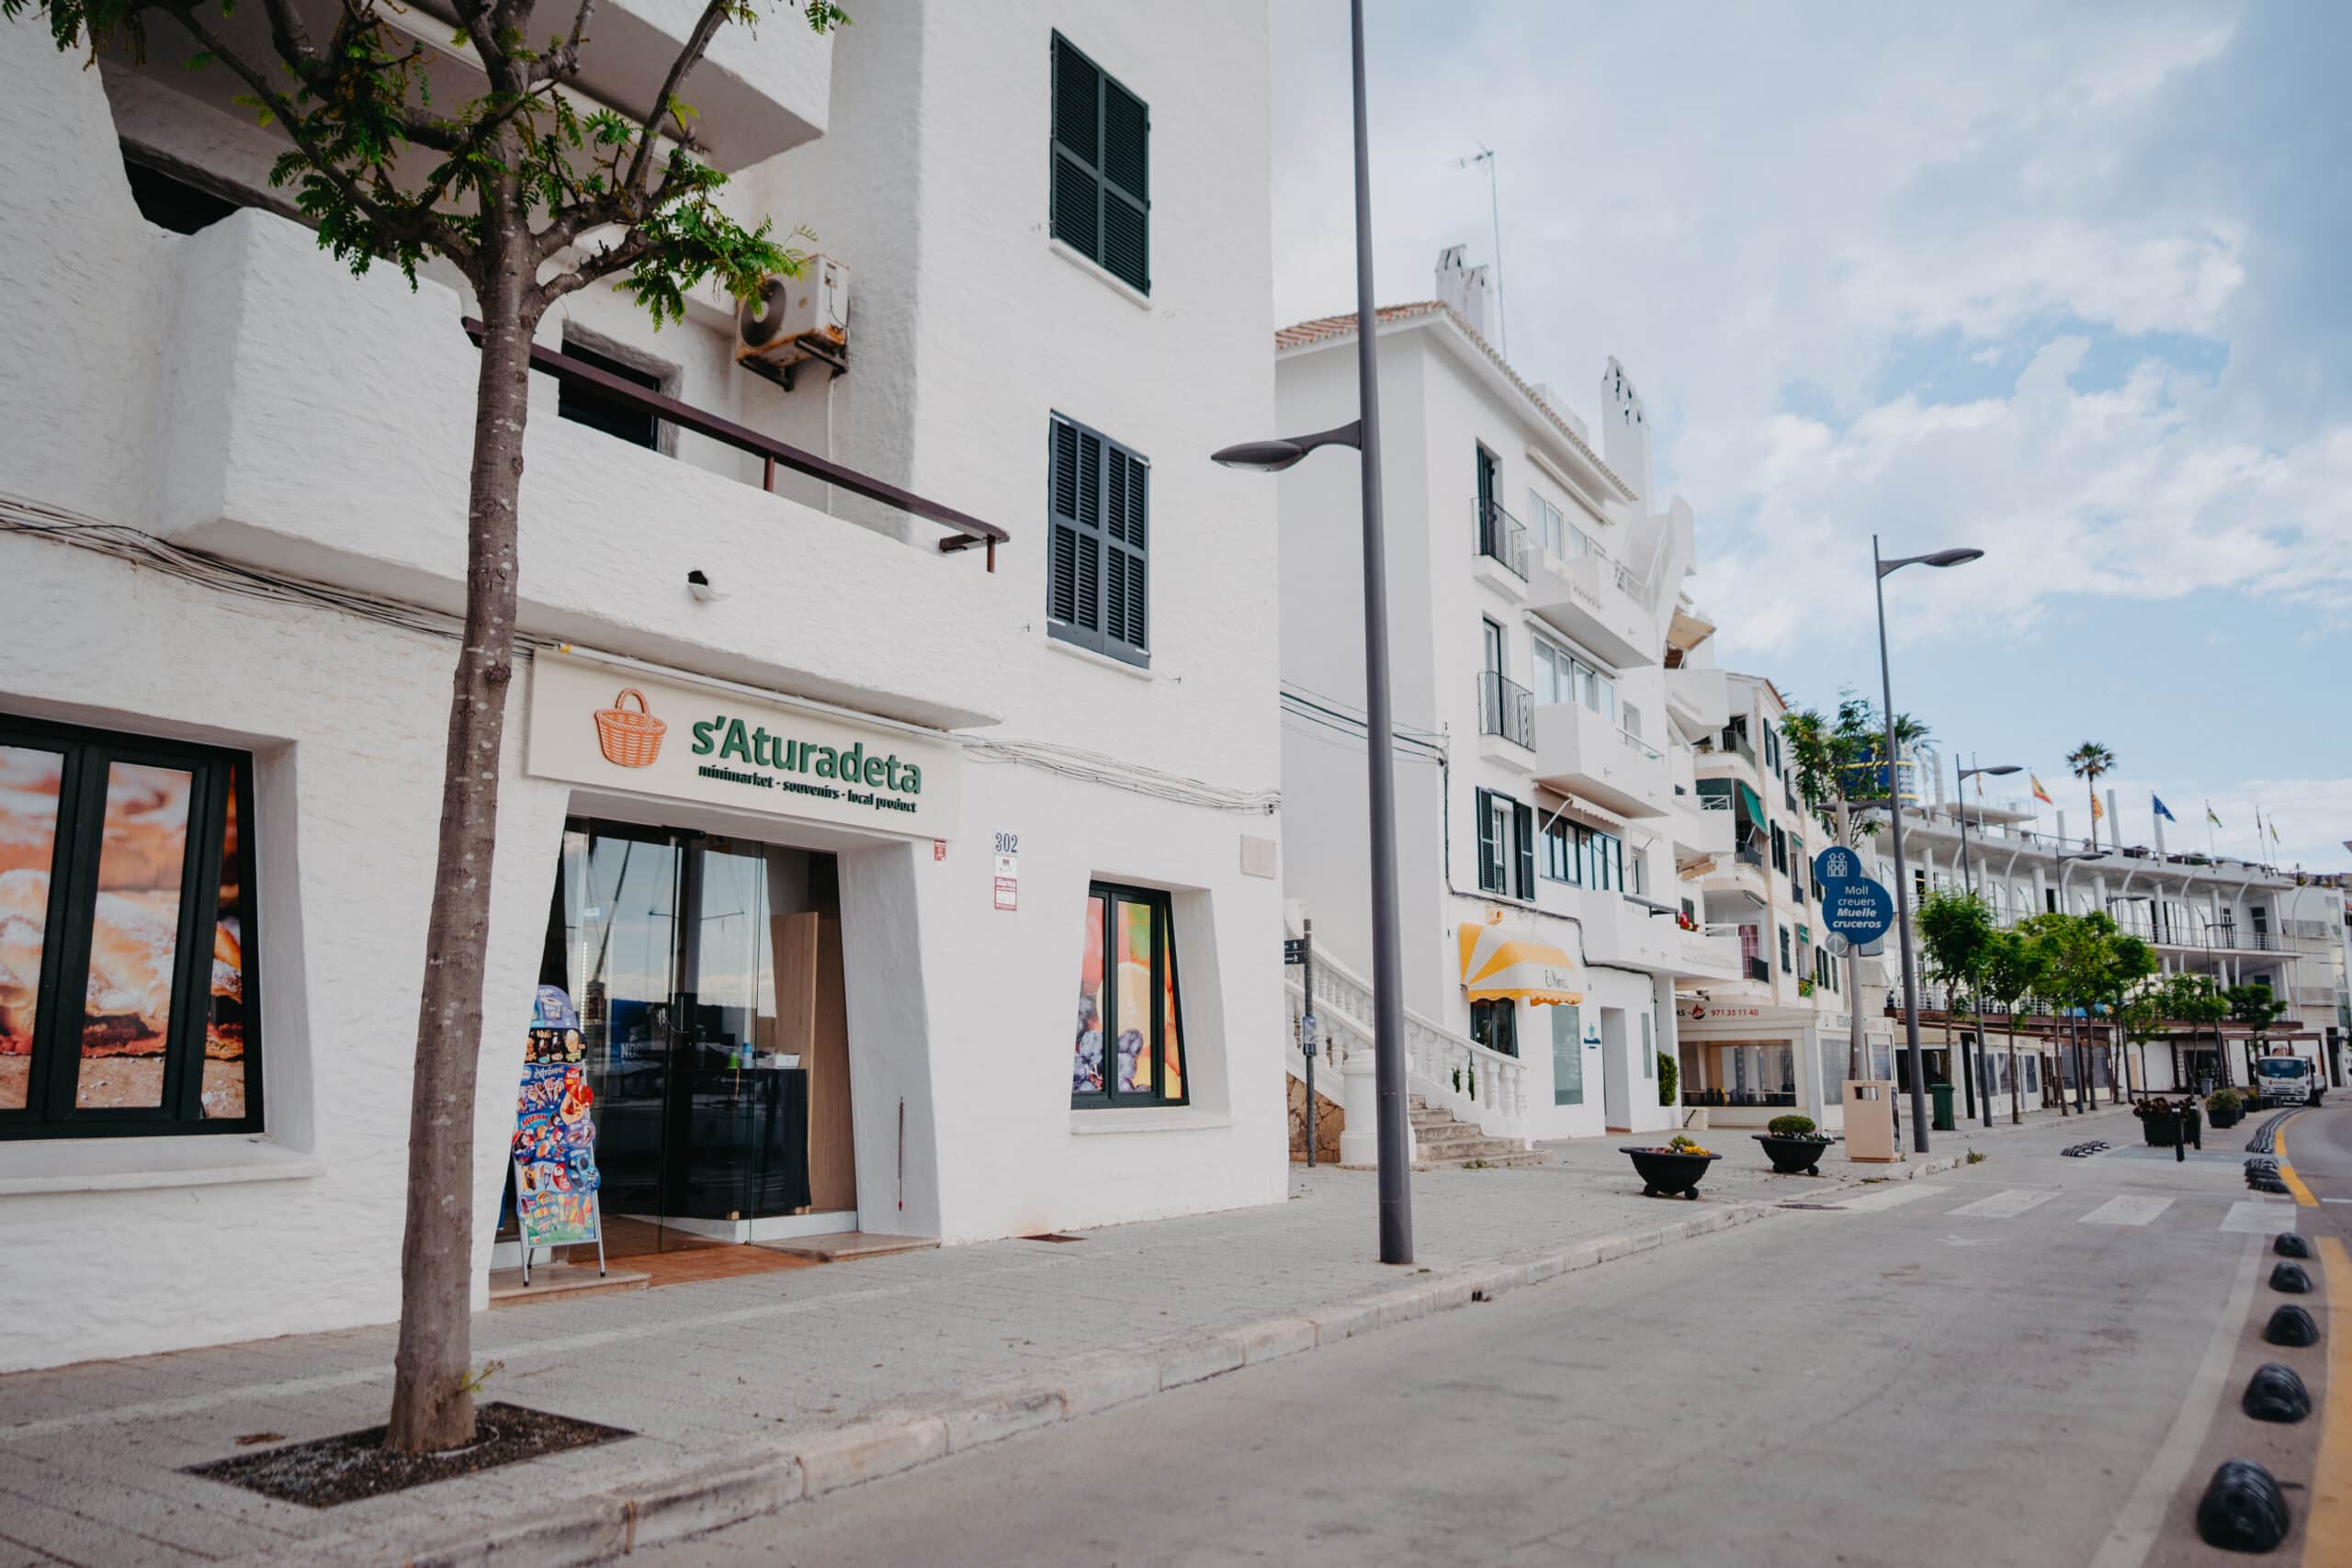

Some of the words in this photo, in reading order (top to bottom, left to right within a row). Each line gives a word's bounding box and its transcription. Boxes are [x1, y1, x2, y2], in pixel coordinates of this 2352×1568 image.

[698, 765, 774, 788] minimarket
[783, 785, 840, 799] souvenirs
[847, 790, 874, 806] local
[876, 798, 917, 813] product
[995, 832, 1018, 853] 302
[1845, 885, 1869, 896] Moll
[1838, 908, 1877, 917] Muelle
